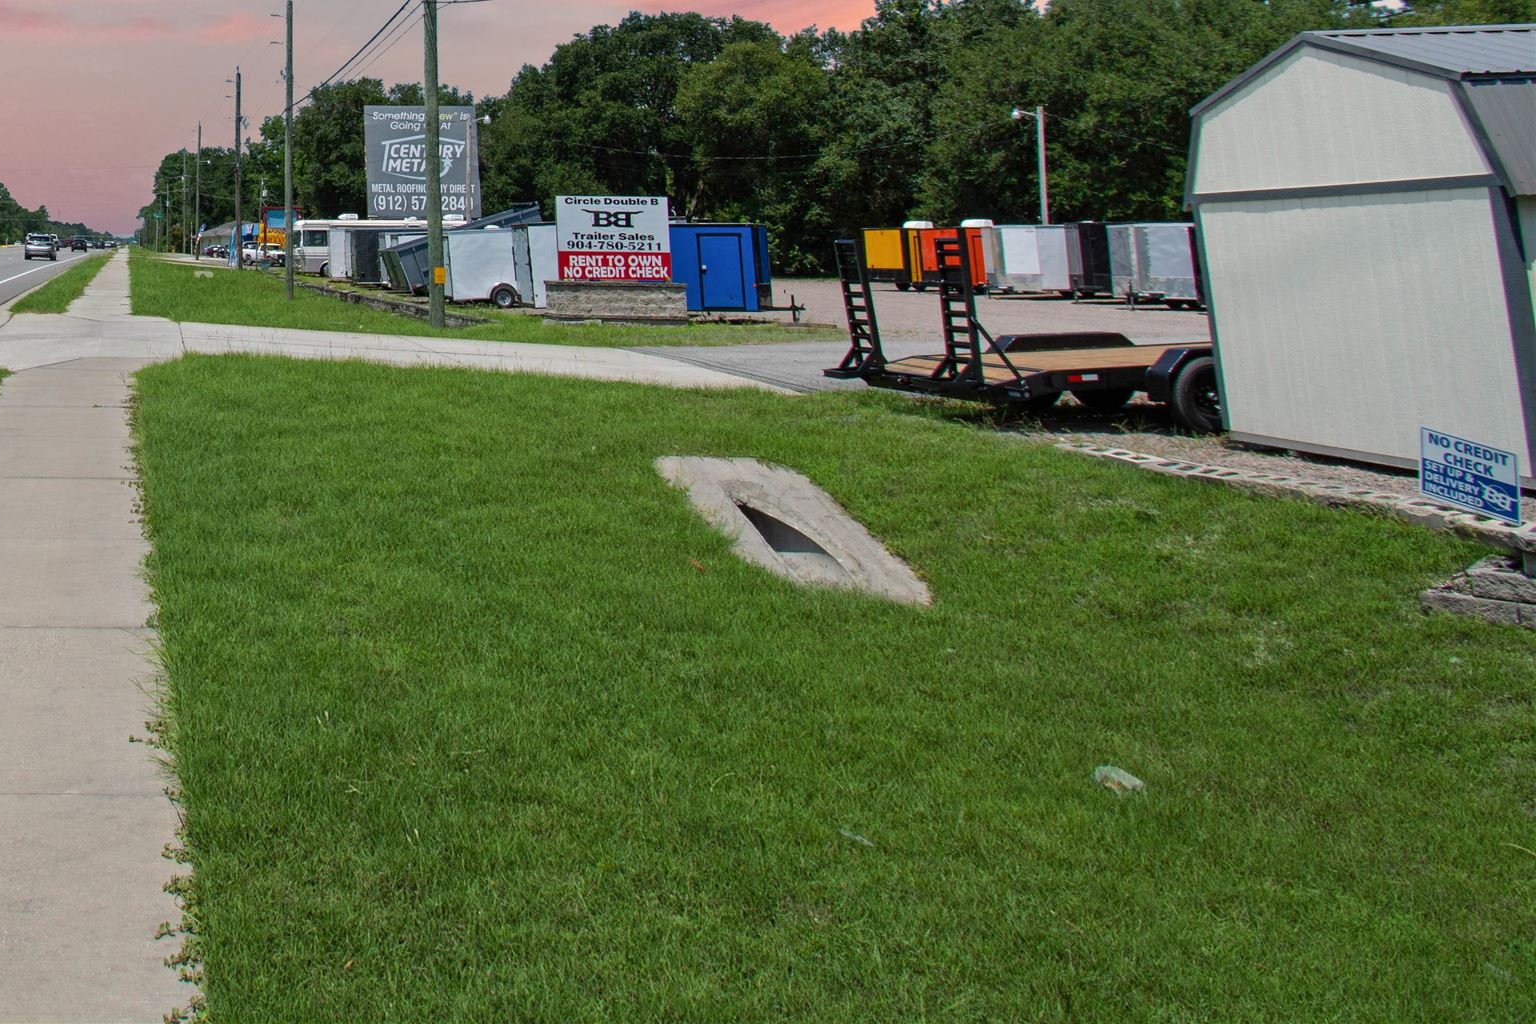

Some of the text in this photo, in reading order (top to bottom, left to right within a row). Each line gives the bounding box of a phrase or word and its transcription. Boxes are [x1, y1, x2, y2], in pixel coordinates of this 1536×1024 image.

[373, 112, 468, 121] Something ew" Is
[390, 122, 420, 131] Going
[440, 122, 451, 130] At
[372, 184, 395, 193] METAL
[450, 185, 475, 193] DIRET
[374, 195, 407, 212] (912)
[565, 197, 600, 205] Circle
[572, 232, 615, 240] Trailer
[567, 241, 662, 250] 904-780-5211
[569, 256, 662, 266] RENT TO OWN
[564, 266, 668, 278] NO CREDIT CHECK
[1429, 433, 1508, 466] NO CREDIT
[1444, 453, 1494, 477] CHECK
[1424, 461, 1475, 483] SET UP &
[1425, 472, 1480, 495] DELIVERY
[1425, 483, 1484, 507] INCLUDED
